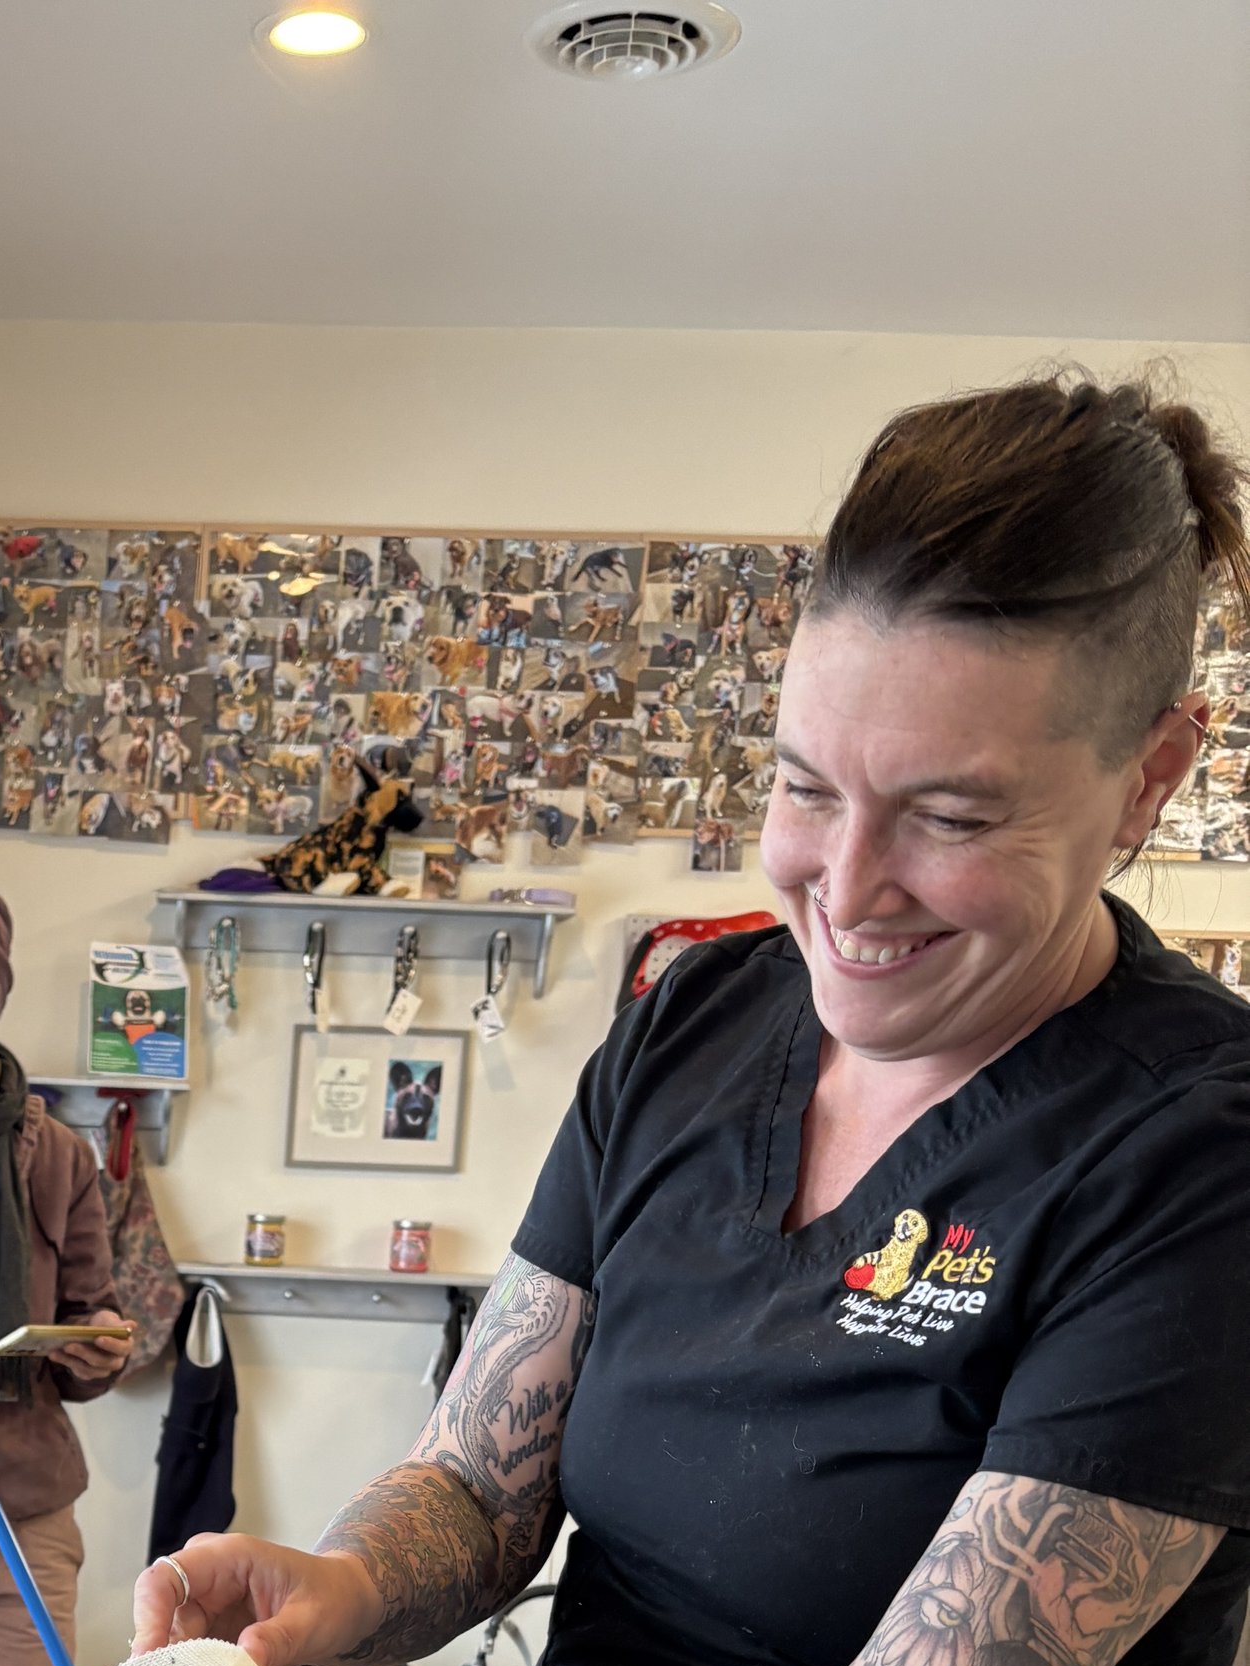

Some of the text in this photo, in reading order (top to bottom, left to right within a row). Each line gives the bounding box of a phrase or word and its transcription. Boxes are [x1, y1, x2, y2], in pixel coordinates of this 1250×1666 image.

[942, 1223, 975, 1254] My
[921, 1246, 997, 1284] Pet's
[840, 1293, 893, 1323] Helping
[891, 1306, 922, 1324] Pets
[901, 1280, 987, 1314] Brace
[488, 1382, 553, 1434] With
[501, 1425, 558, 1476] wonder
